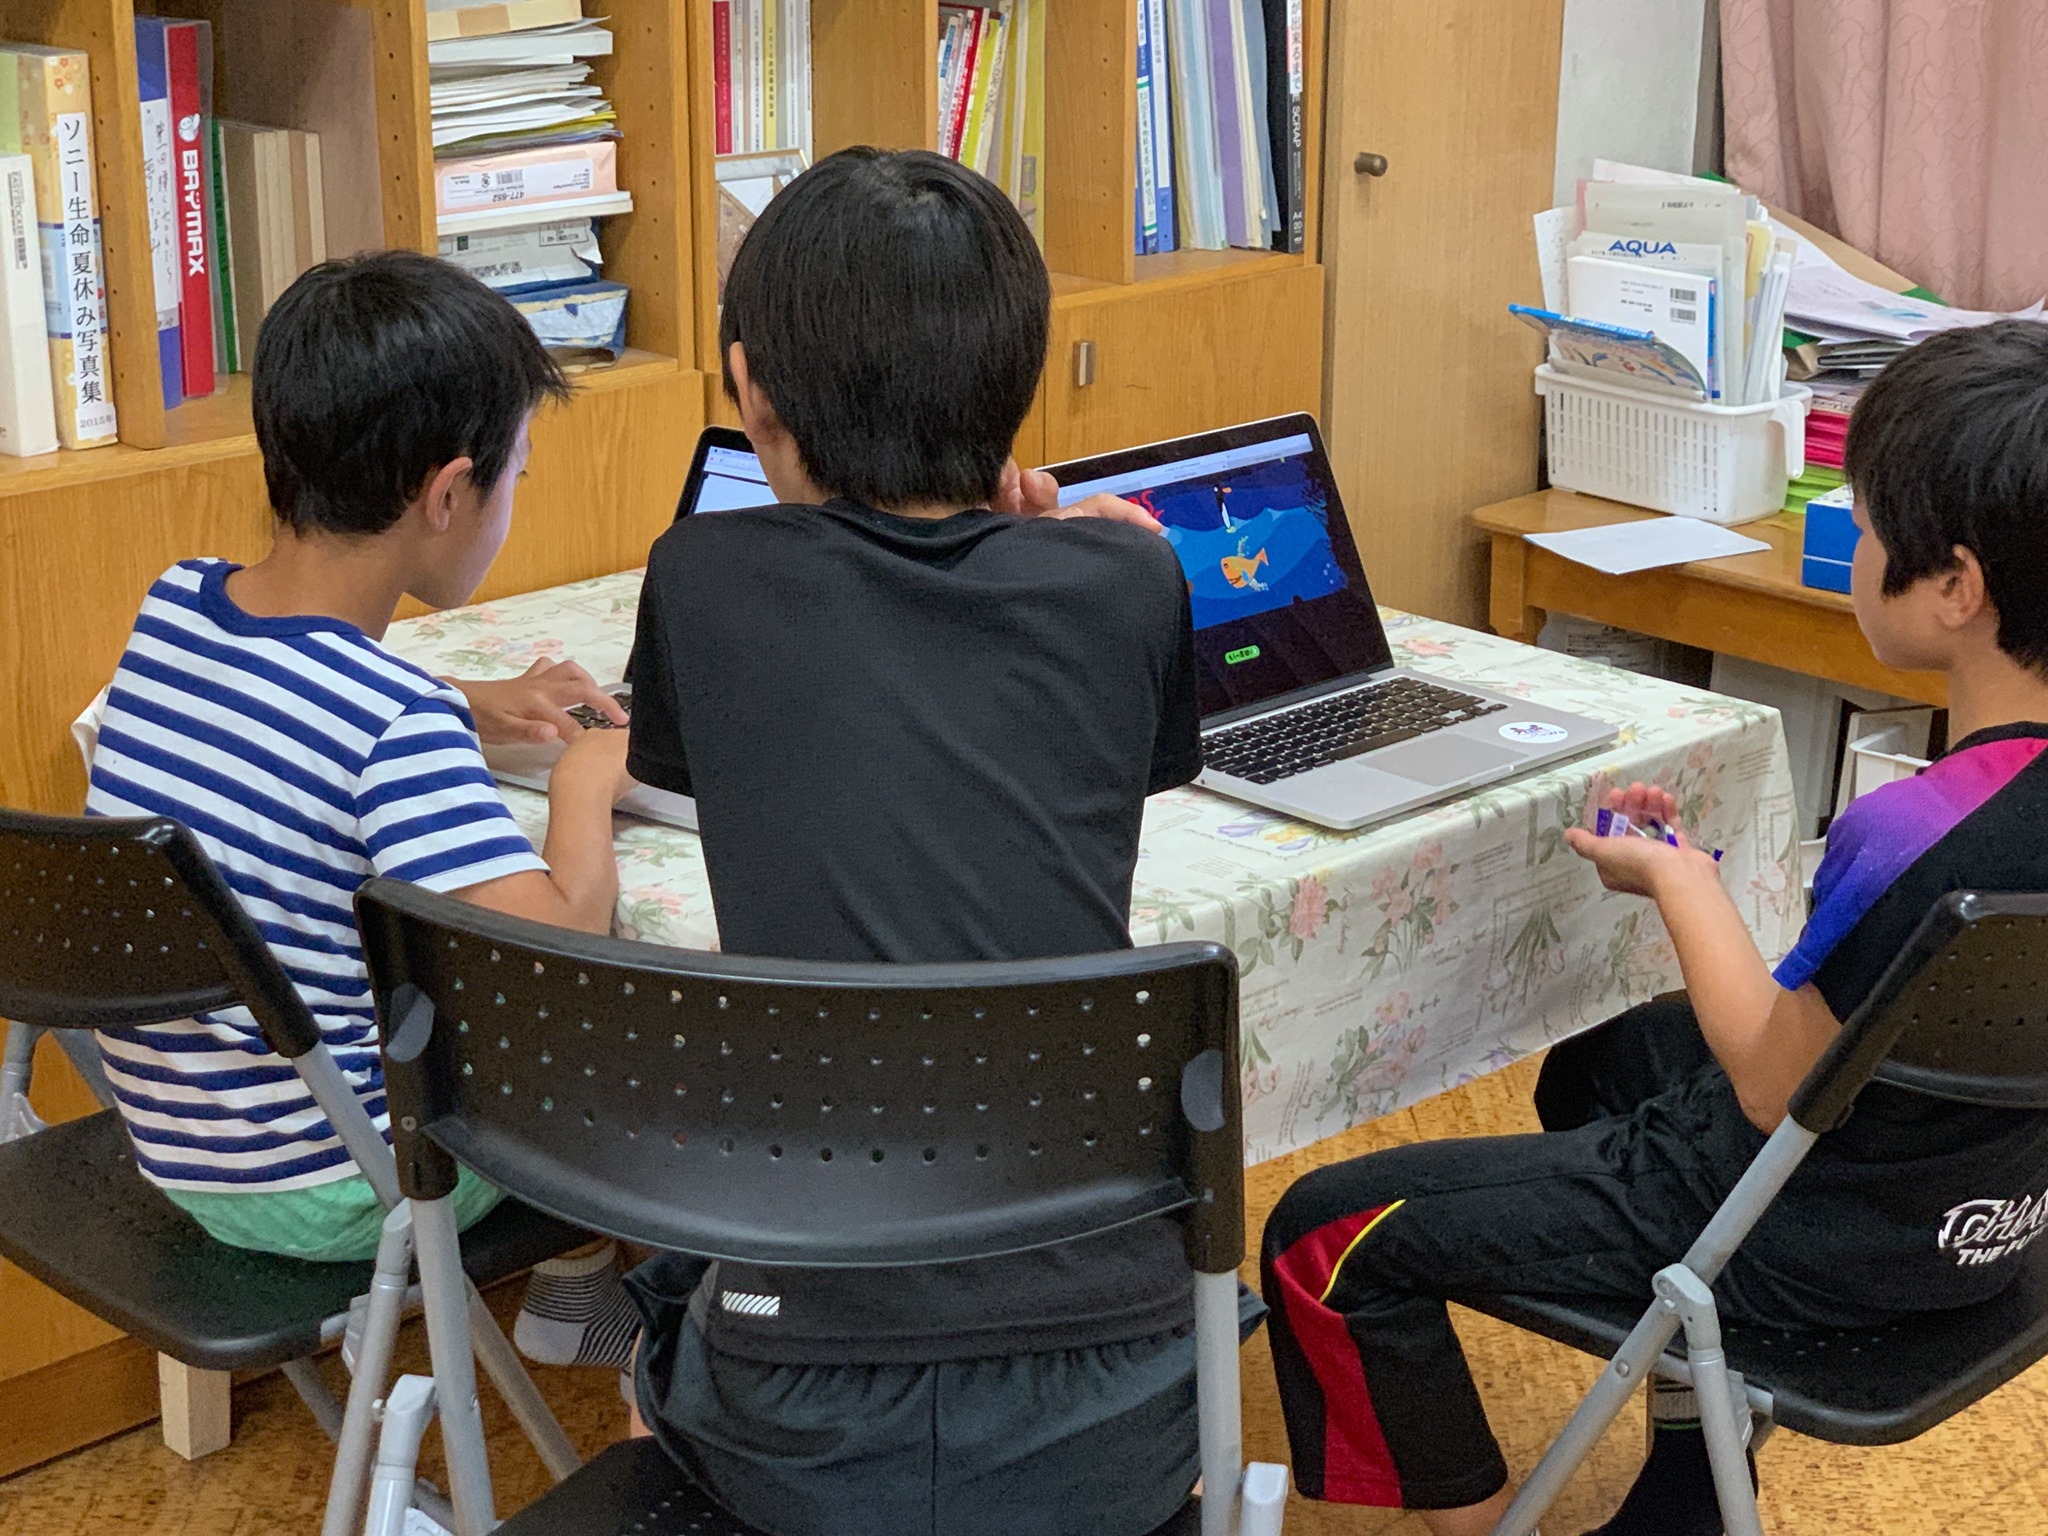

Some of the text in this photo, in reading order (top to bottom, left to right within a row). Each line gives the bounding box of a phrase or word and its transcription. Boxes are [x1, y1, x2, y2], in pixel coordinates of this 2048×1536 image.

[1292, 105, 1301, 148] SCRAP
[11, 170, 20, 194] EASY
[14, 195, 25, 236] STOCKER
[182, 150, 206, 276] BAYMAX
[1608, 240, 1677, 256] AQUA
[80, 415, 114, 428] 2015年
[1956, 1245, 2006, 1265] THE
